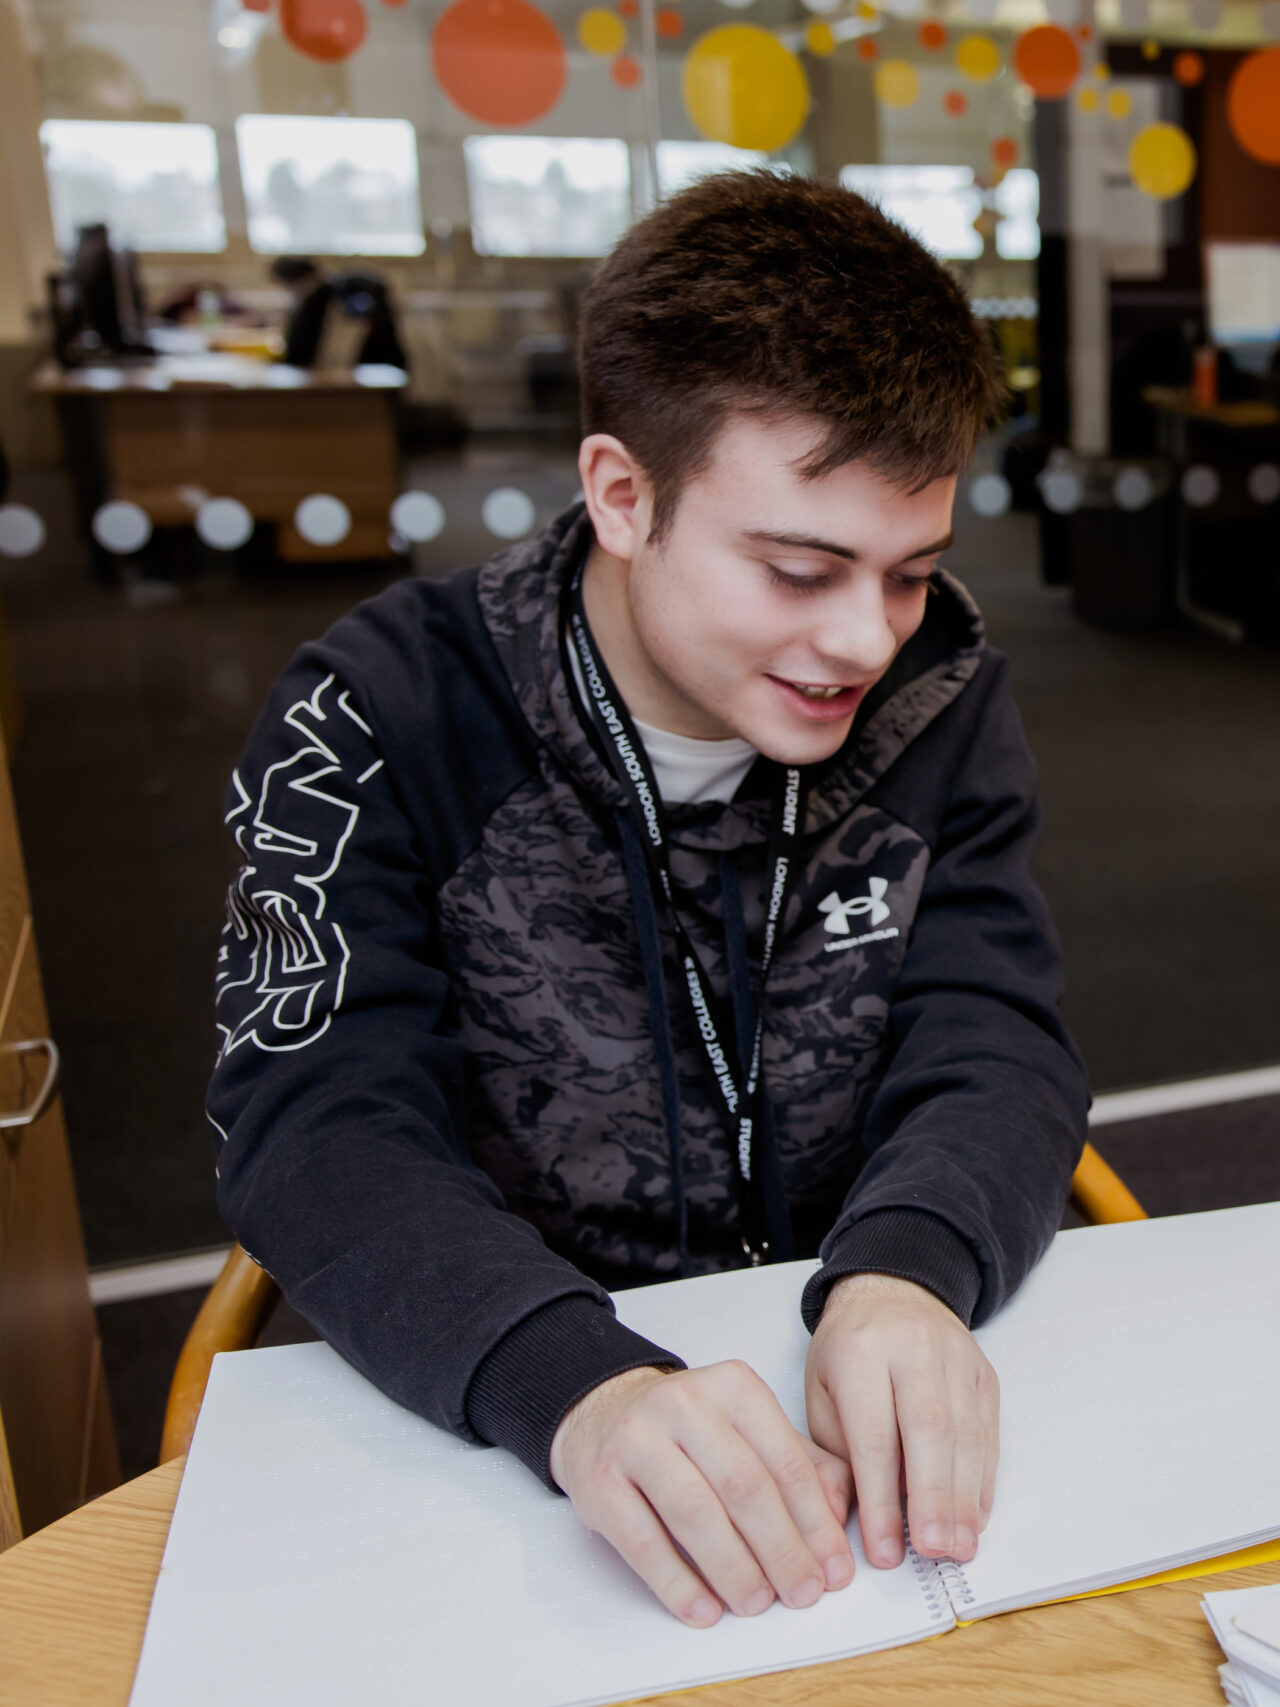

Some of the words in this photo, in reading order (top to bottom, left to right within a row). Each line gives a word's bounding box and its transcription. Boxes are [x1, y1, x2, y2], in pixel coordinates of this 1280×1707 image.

[576, 627, 606, 699] COLLEGES
[597, 700, 625, 735] EAST
[613, 733, 645, 783] SOUTH
[635, 781, 662, 846] LONDON
[782, 769, 800, 836] STUDENT
[768, 856, 789, 921] LONDON
[685, 969, 717, 1041] COLLEGES
[705, 1042, 730, 1076] EAST
[737, 1117, 753, 1182] STUDENT
